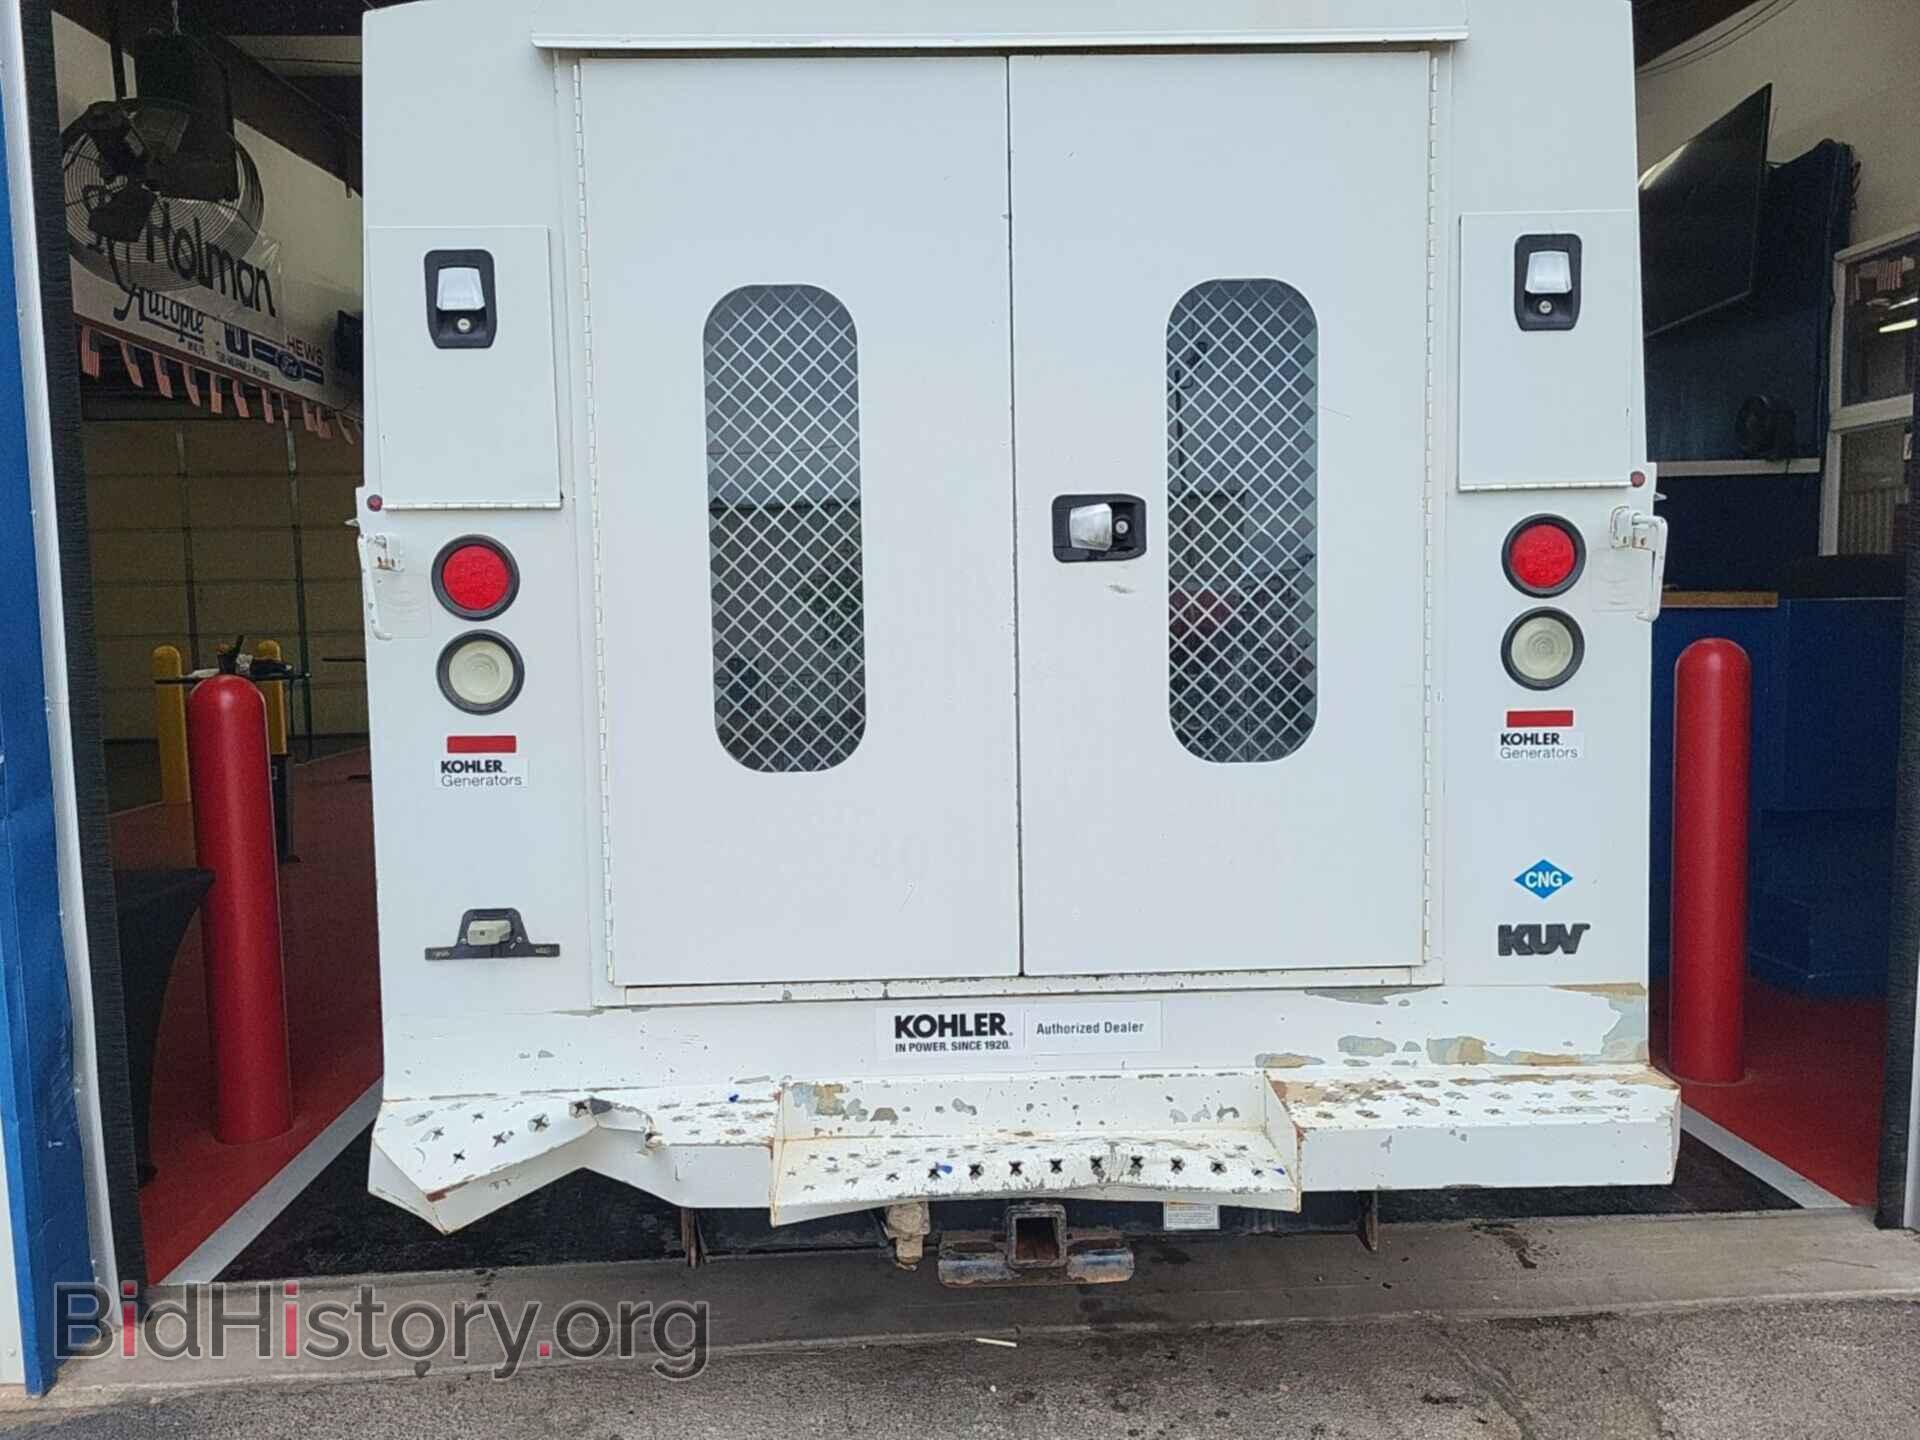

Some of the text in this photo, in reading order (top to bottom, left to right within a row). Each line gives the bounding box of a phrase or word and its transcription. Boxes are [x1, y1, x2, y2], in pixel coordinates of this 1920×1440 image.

[1500, 747, 1579, 760] Generators
[441, 774, 523, 788] Generators
[1525, 870, 1564, 888] CNG
[1498, 923, 1591, 956] KUV
[1036, 1021, 1144, 1035] Authorized Dealer
[895, 1042, 906, 1053] IN
[908, 1041, 949, 1052] POWER.
[951, 1040, 982, 1052] SINCE
